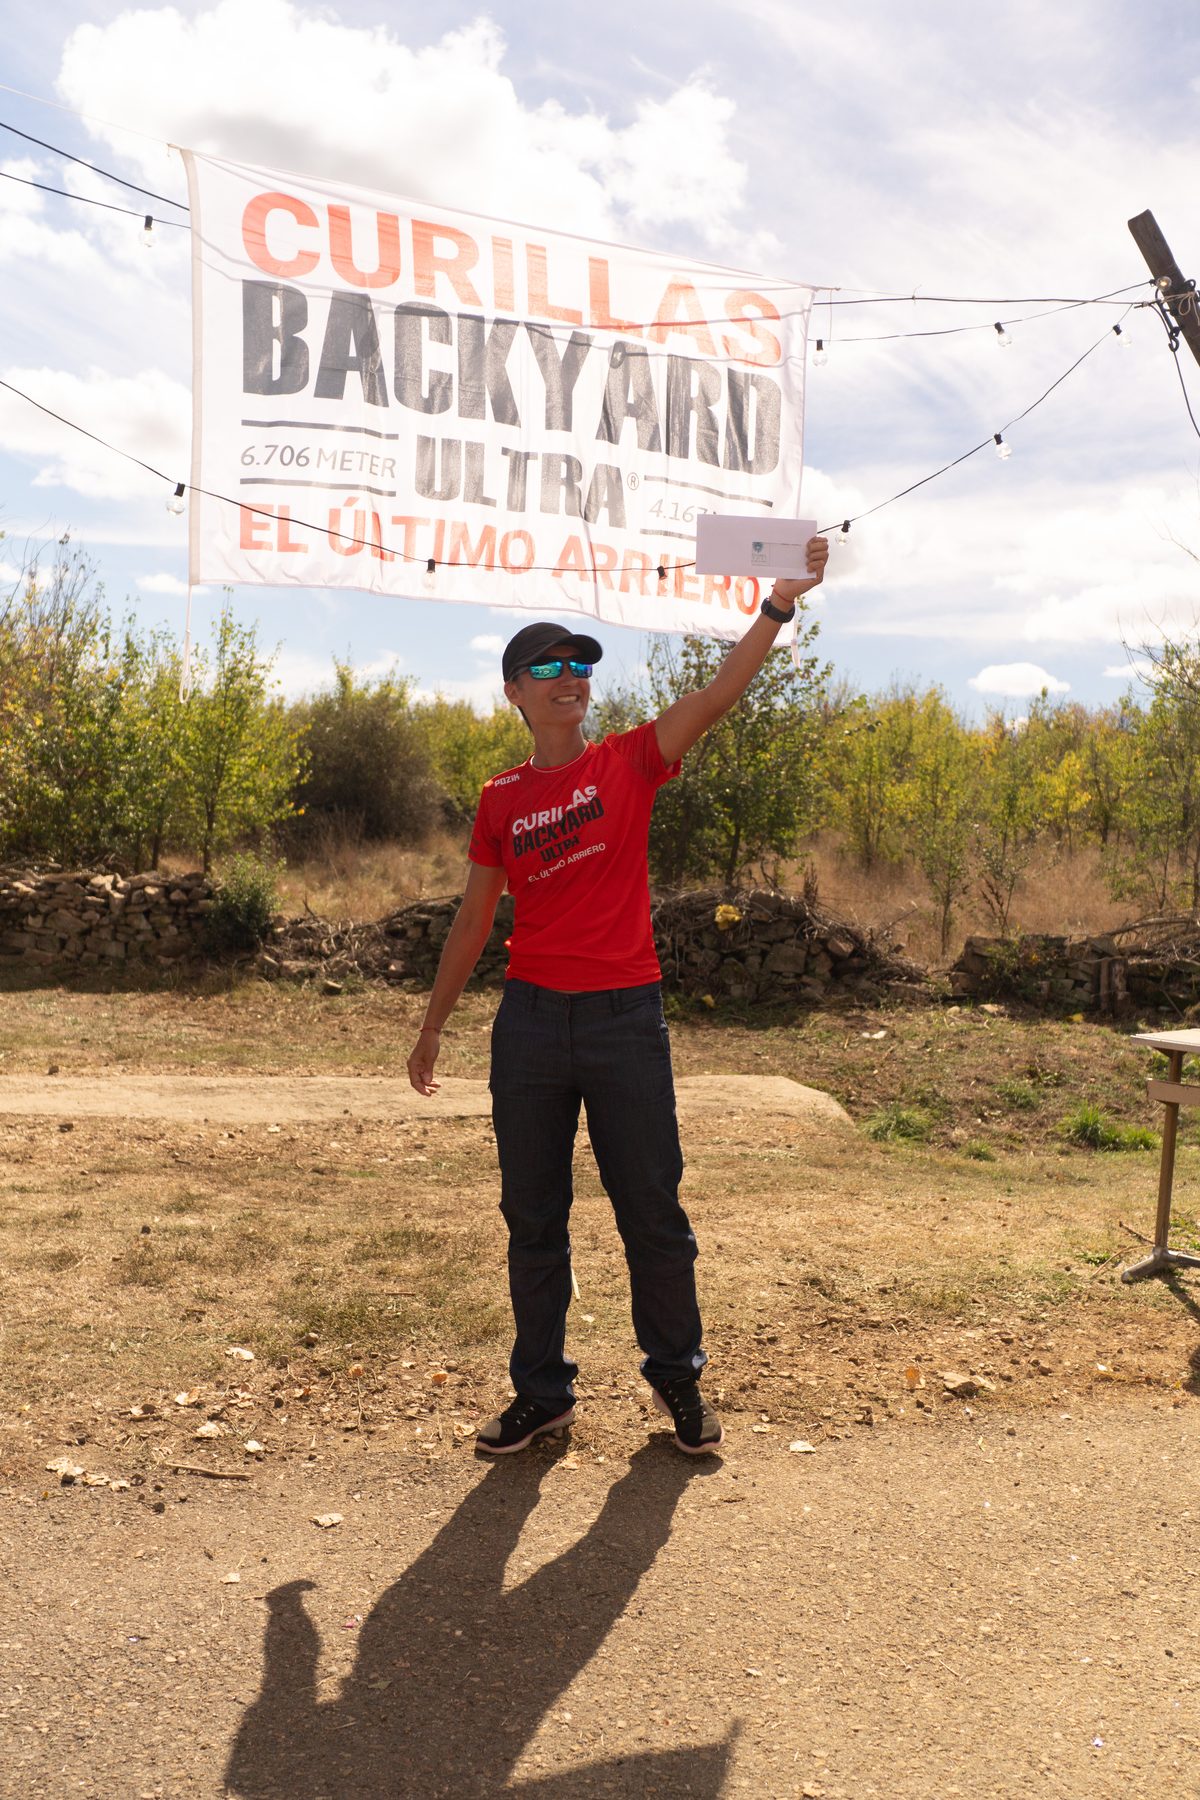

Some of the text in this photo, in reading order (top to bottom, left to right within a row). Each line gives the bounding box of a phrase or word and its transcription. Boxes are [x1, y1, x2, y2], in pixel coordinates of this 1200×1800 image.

[241, 191, 782, 367] CURILLAS
[241, 279, 783, 476] BACKYARD
[240, 444, 397, 479] 6.706 METER
[239, 496, 761, 616] EL ÚLTIMO ARRIERO
[512, 785, 597, 835] CURILAS
[513, 797, 604, 858] BACKYARD
[528, 875, 540, 883] EL
[567, 842, 606, 864] ARRIERO
[540, 834, 580, 862] ULTRA
